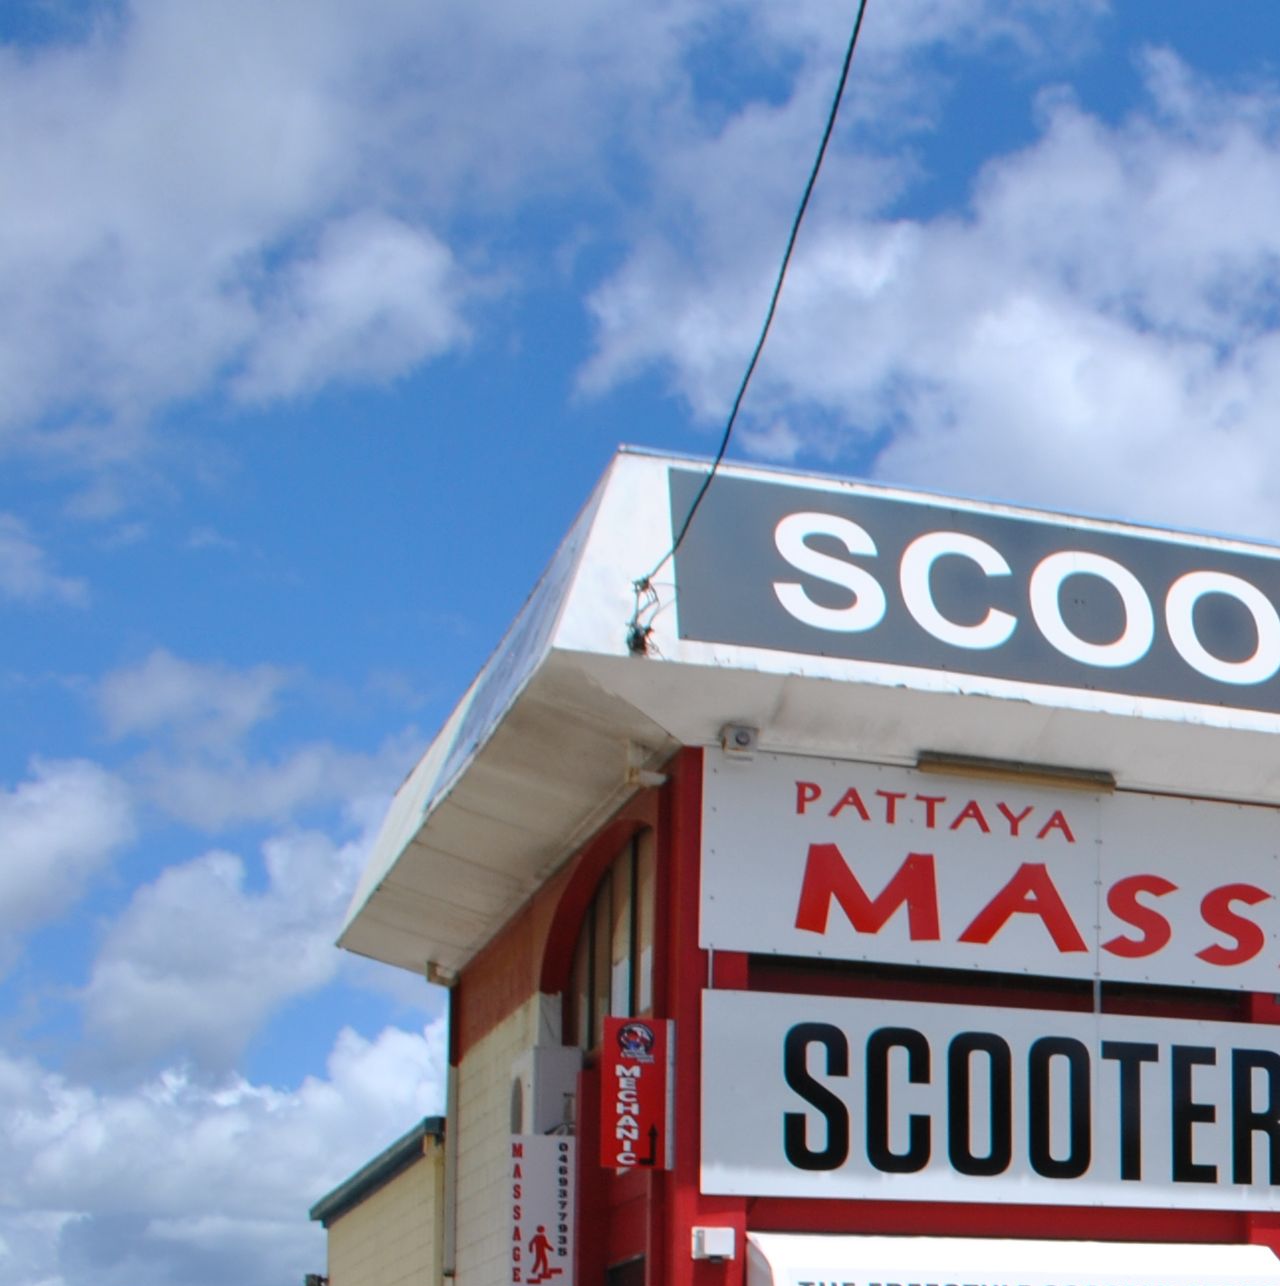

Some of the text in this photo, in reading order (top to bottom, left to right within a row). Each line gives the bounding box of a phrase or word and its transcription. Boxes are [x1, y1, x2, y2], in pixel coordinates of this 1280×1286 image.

[794, 781, 1075, 843] PATTAYA
[615, 1064, 641, 1166] MECHANIC
[511, 1142, 523, 1282] MASSAGE
